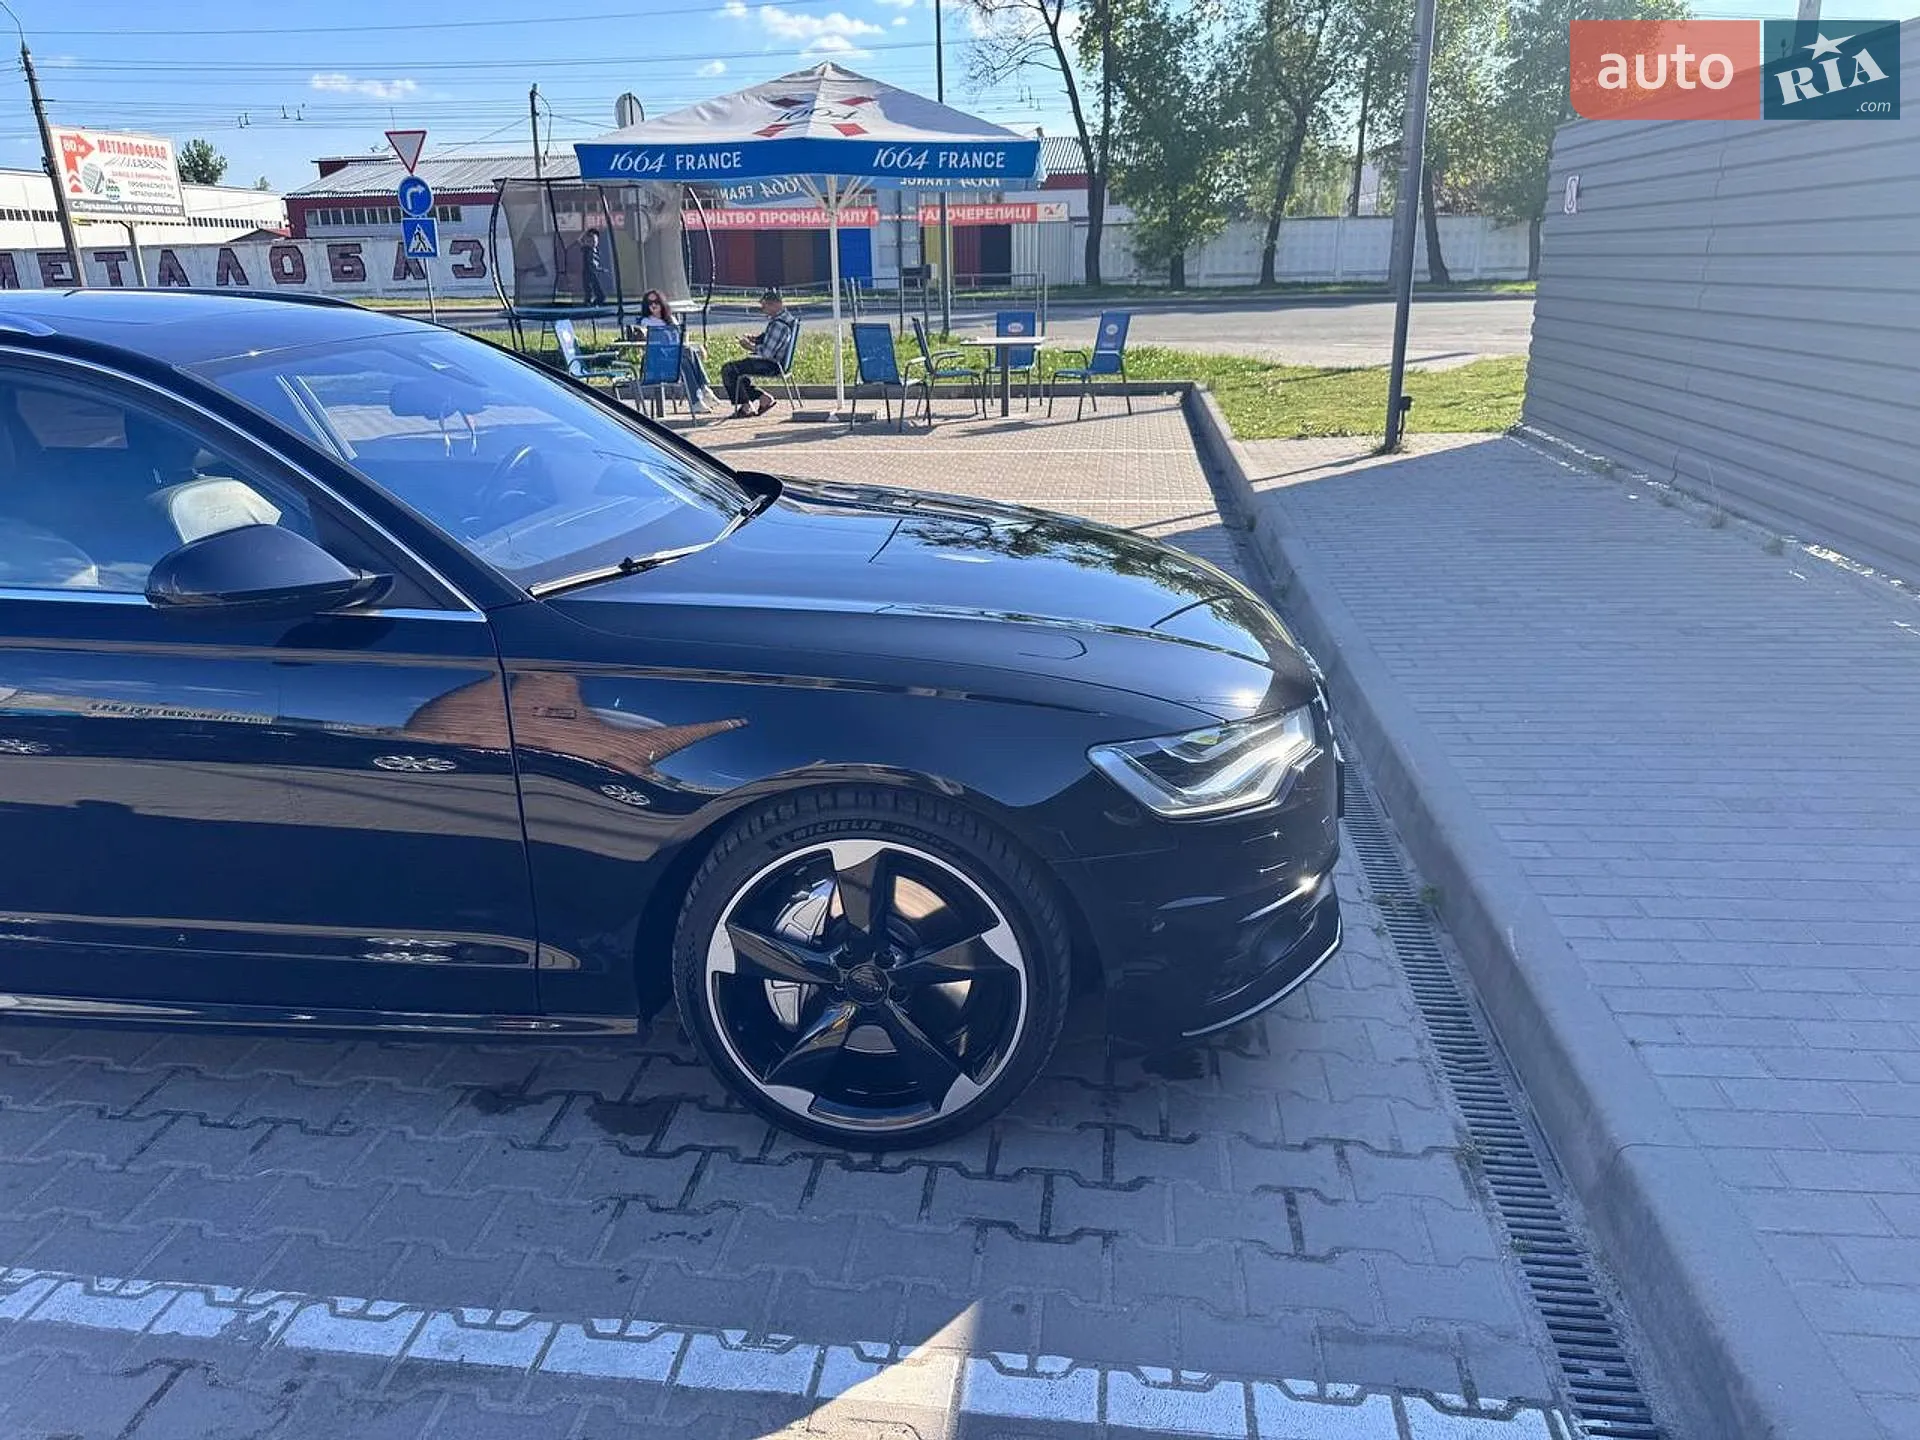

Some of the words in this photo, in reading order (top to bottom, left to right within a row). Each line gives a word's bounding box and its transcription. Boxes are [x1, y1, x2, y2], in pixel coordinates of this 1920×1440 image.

[610, 149, 666, 173] 1664
[676, 151, 742, 171] FRANCE
[872, 147, 930, 170] 1664
[938, 151, 1006, 169] FRANCE
[793, 818, 882, 841] MICHELIN
